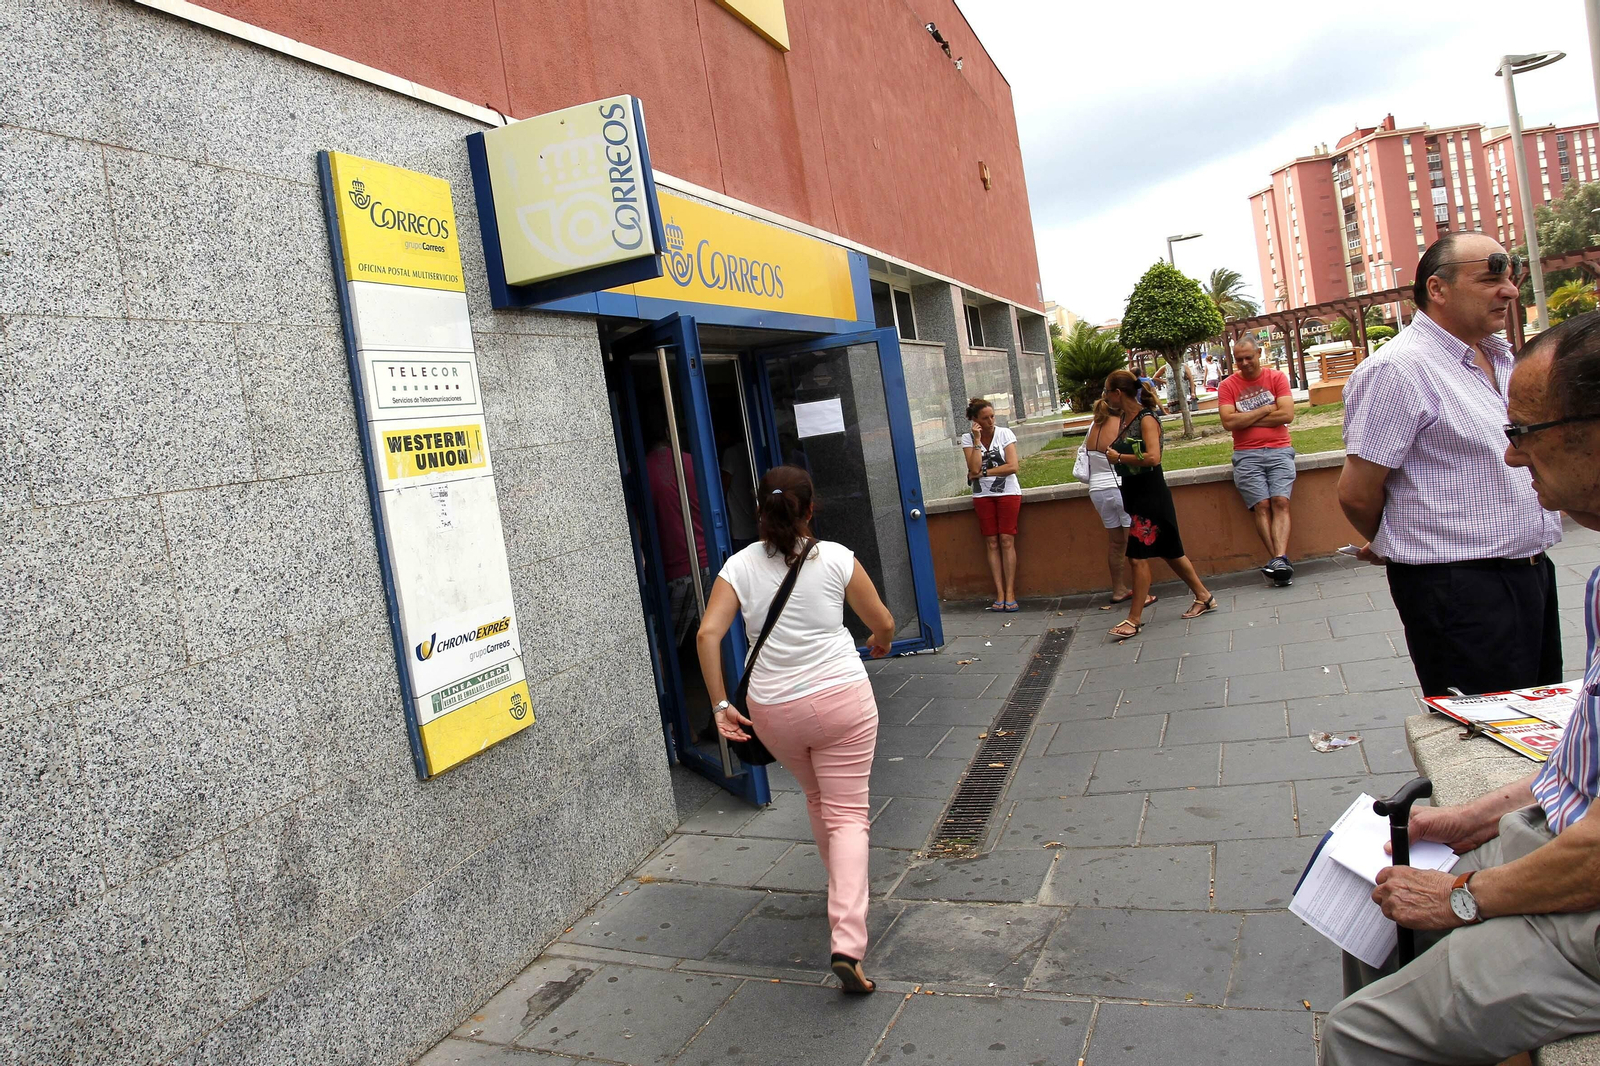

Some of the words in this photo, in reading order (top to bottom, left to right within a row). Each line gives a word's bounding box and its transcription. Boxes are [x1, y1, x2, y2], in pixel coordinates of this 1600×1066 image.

[599, 103, 644, 250] CORREOS
[370, 201, 449, 239] CORREOS
[358, 263, 386, 274] OFICINA
[388, 267, 411, 277] POSTAL
[412, 270, 459, 283] MULTISERVICIOS
[697, 239, 784, 299] CORREOS
[388, 367, 458, 377] TELECOR
[387, 431, 466, 453] WESTERN
[415, 449, 468, 470] UNION
[477, 665, 508, 681] VERDE
[444, 696, 456, 707] VENTA
